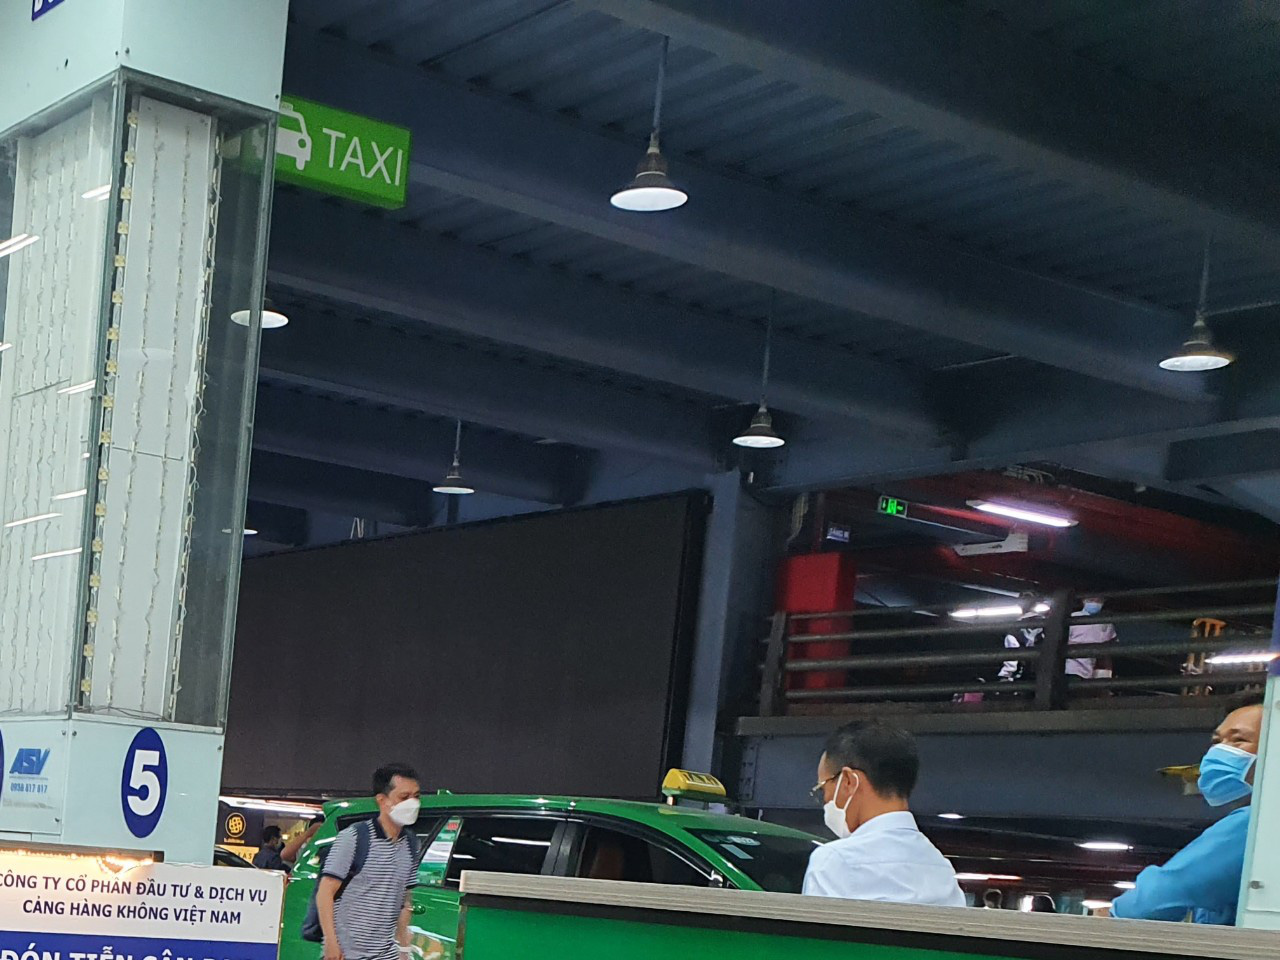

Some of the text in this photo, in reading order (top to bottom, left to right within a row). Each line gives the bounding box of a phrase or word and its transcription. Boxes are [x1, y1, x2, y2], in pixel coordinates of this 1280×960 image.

[322, 127, 403, 187] TAXI
[9, 747, 51, 776] ASV
[126, 748, 161, 817] 5
[42, 876, 61, 891] TY
[65, 873, 88, 892] CỔ
[136, 877, 167, 897] ĐẦU
[170, 883, 193, 898] TƯ
[194, 886, 204, 899] &
[208, 886, 245, 904] DỊCH
[248, 889, 268, 907] VỤ
[22, 895, 242, 926] CẢNG HÀNG KHÔNG VIỆT NAM
